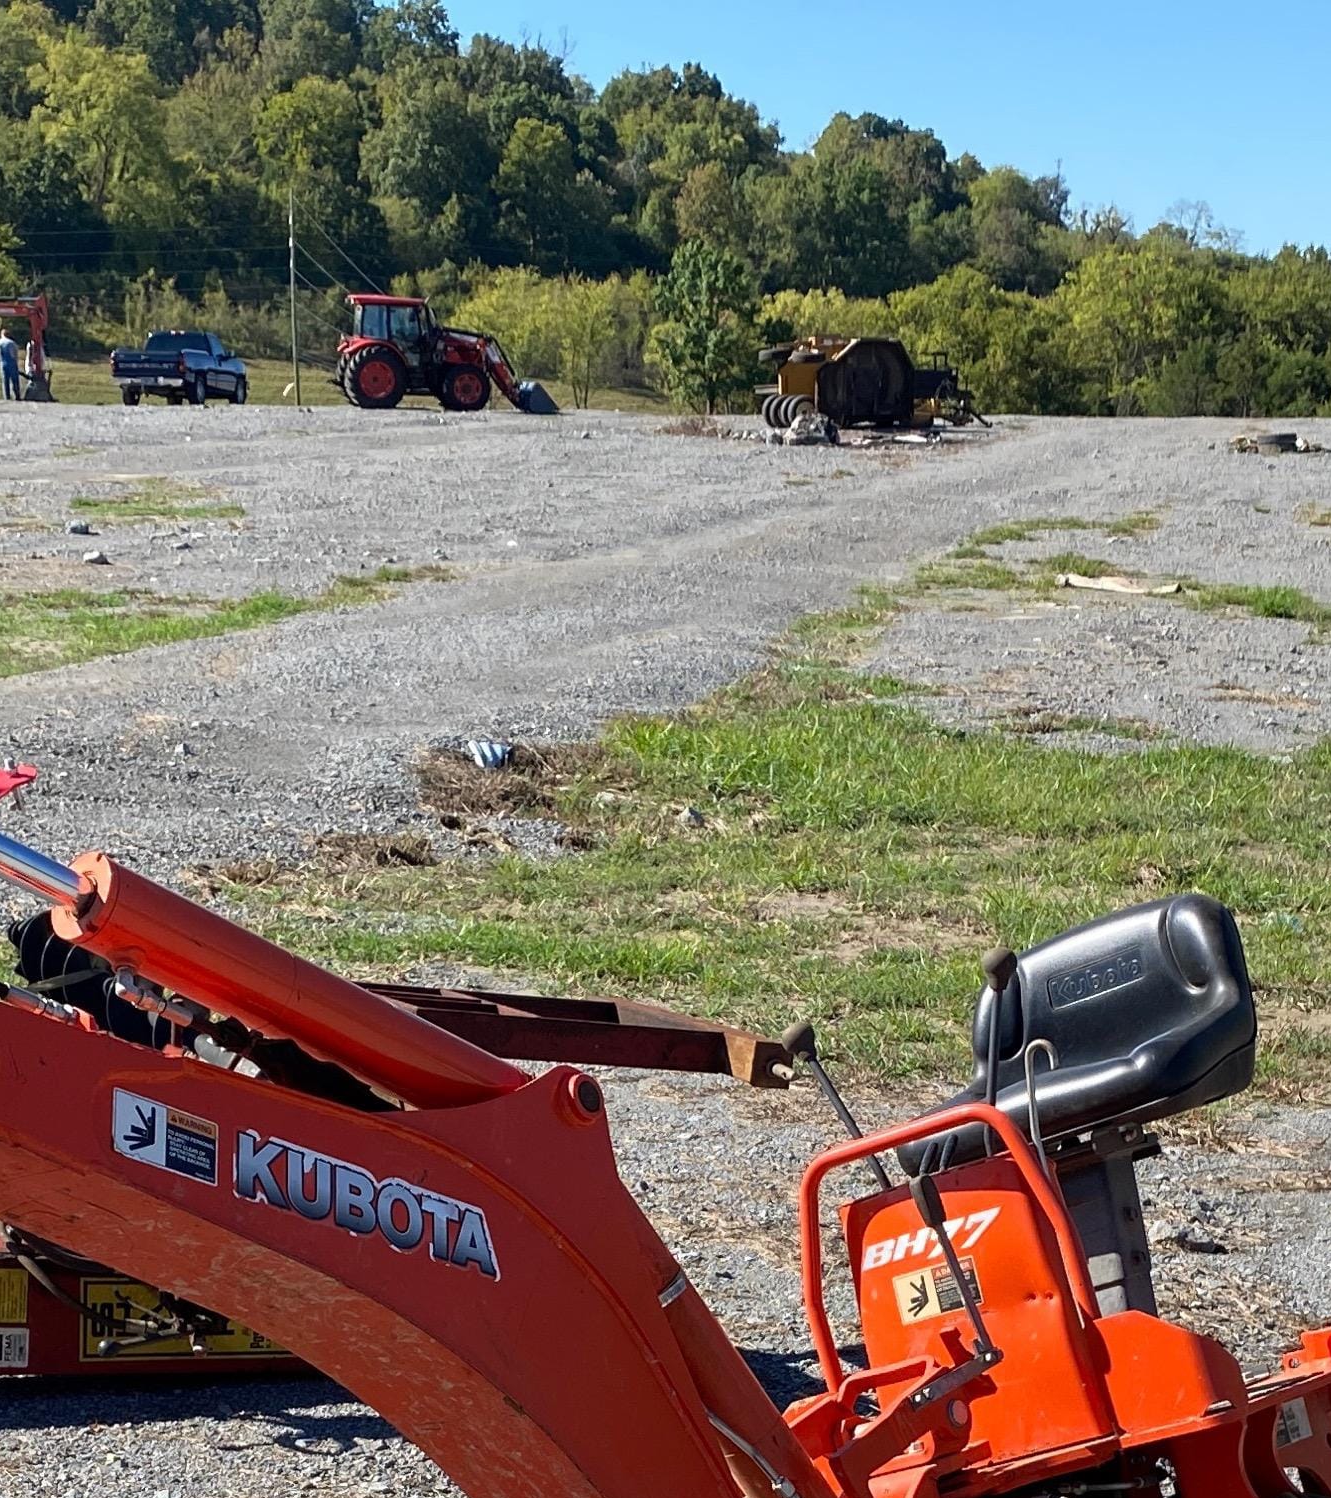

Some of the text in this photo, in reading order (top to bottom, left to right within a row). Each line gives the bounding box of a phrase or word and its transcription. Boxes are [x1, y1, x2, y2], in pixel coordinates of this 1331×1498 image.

[178, 1115, 213, 1135] WARNING
[234, 1129, 498, 1278] KUBOTA
[861, 1205, 1002, 1272] BH77
[4, 1334, 12, 1362] FEMA
